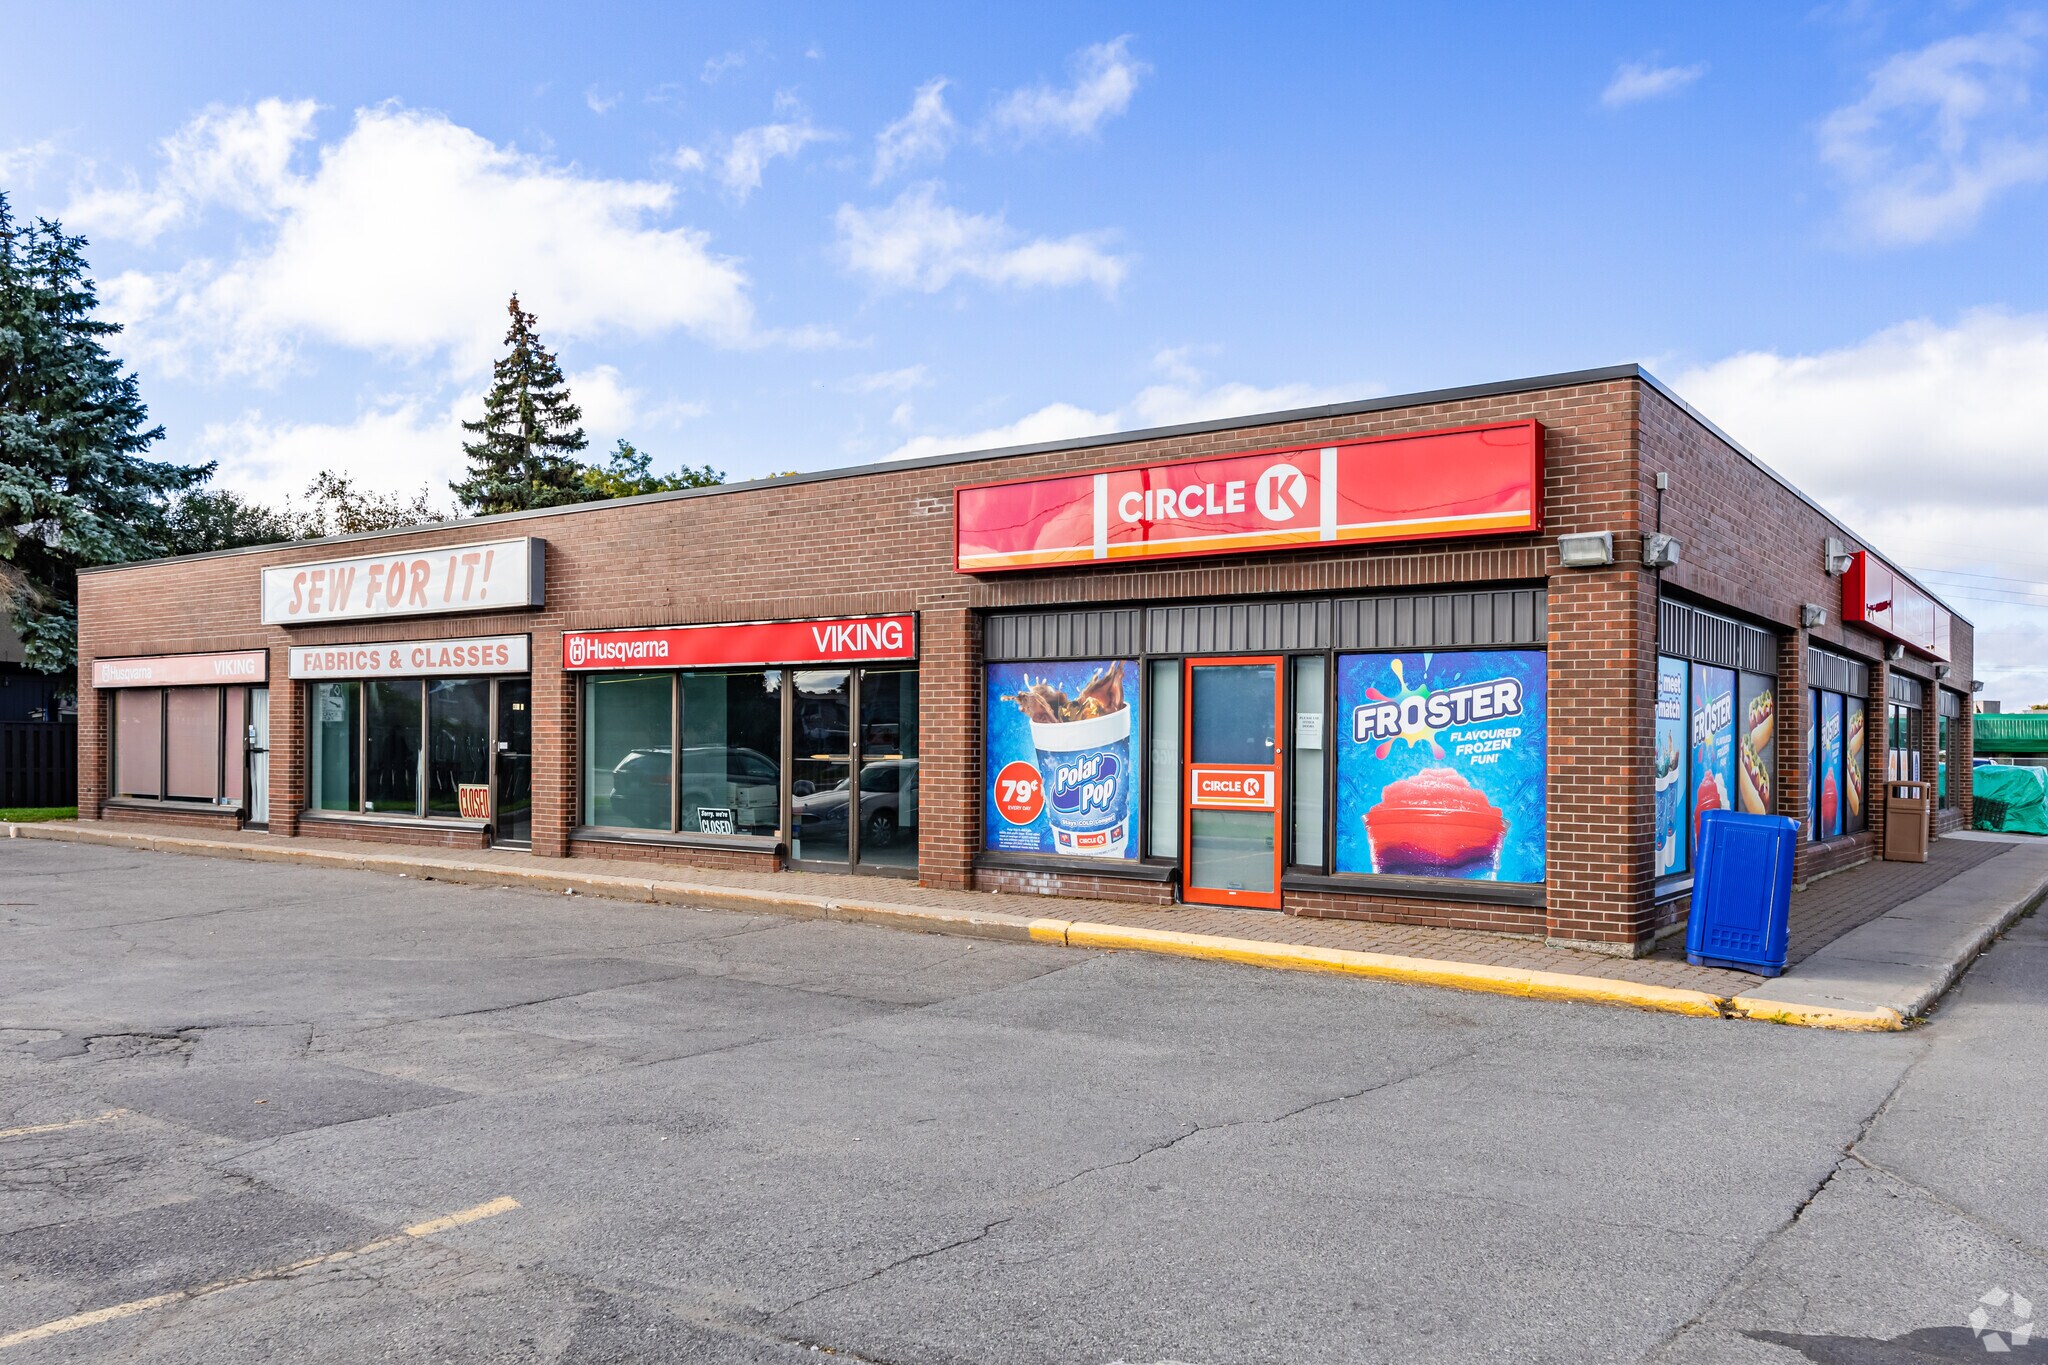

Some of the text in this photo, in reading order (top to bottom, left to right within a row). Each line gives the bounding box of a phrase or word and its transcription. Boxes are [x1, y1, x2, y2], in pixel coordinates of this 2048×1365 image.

[1118, 480, 1246, 523] CIRCLE
[288, 549, 495, 615] SEW FOR IT!
[812, 621, 903, 653] VIKING
[303, 644, 509, 671] FABRICS & CLASSES
[586, 637, 669, 663] Husqvarna
[110, 665, 152, 682] Husqvarna
[214, 658, 255, 675] VIKING
[1663, 673, 1681, 695] meet
[1356, 681, 1519, 740] FROSTER
[1658, 698, 1681, 720] match
[1694, 694, 1731, 746] FROSTER
[1450, 727, 1522, 743] FLAVOURED
[1456, 738, 1511, 756] FROZEN
[1470, 753, 1499, 765] FUN!
[1057, 757, 1100, 792] Polar
[1202, 780, 1241, 792] CIRCLE
[460, 787, 490, 819] CLOSED
[1001, 779, 1038, 803] 79¢
[1082, 778, 1114, 811] Pop
[701, 810, 714, 818] Sorry,
[701, 819, 731, 835] CLOSED
